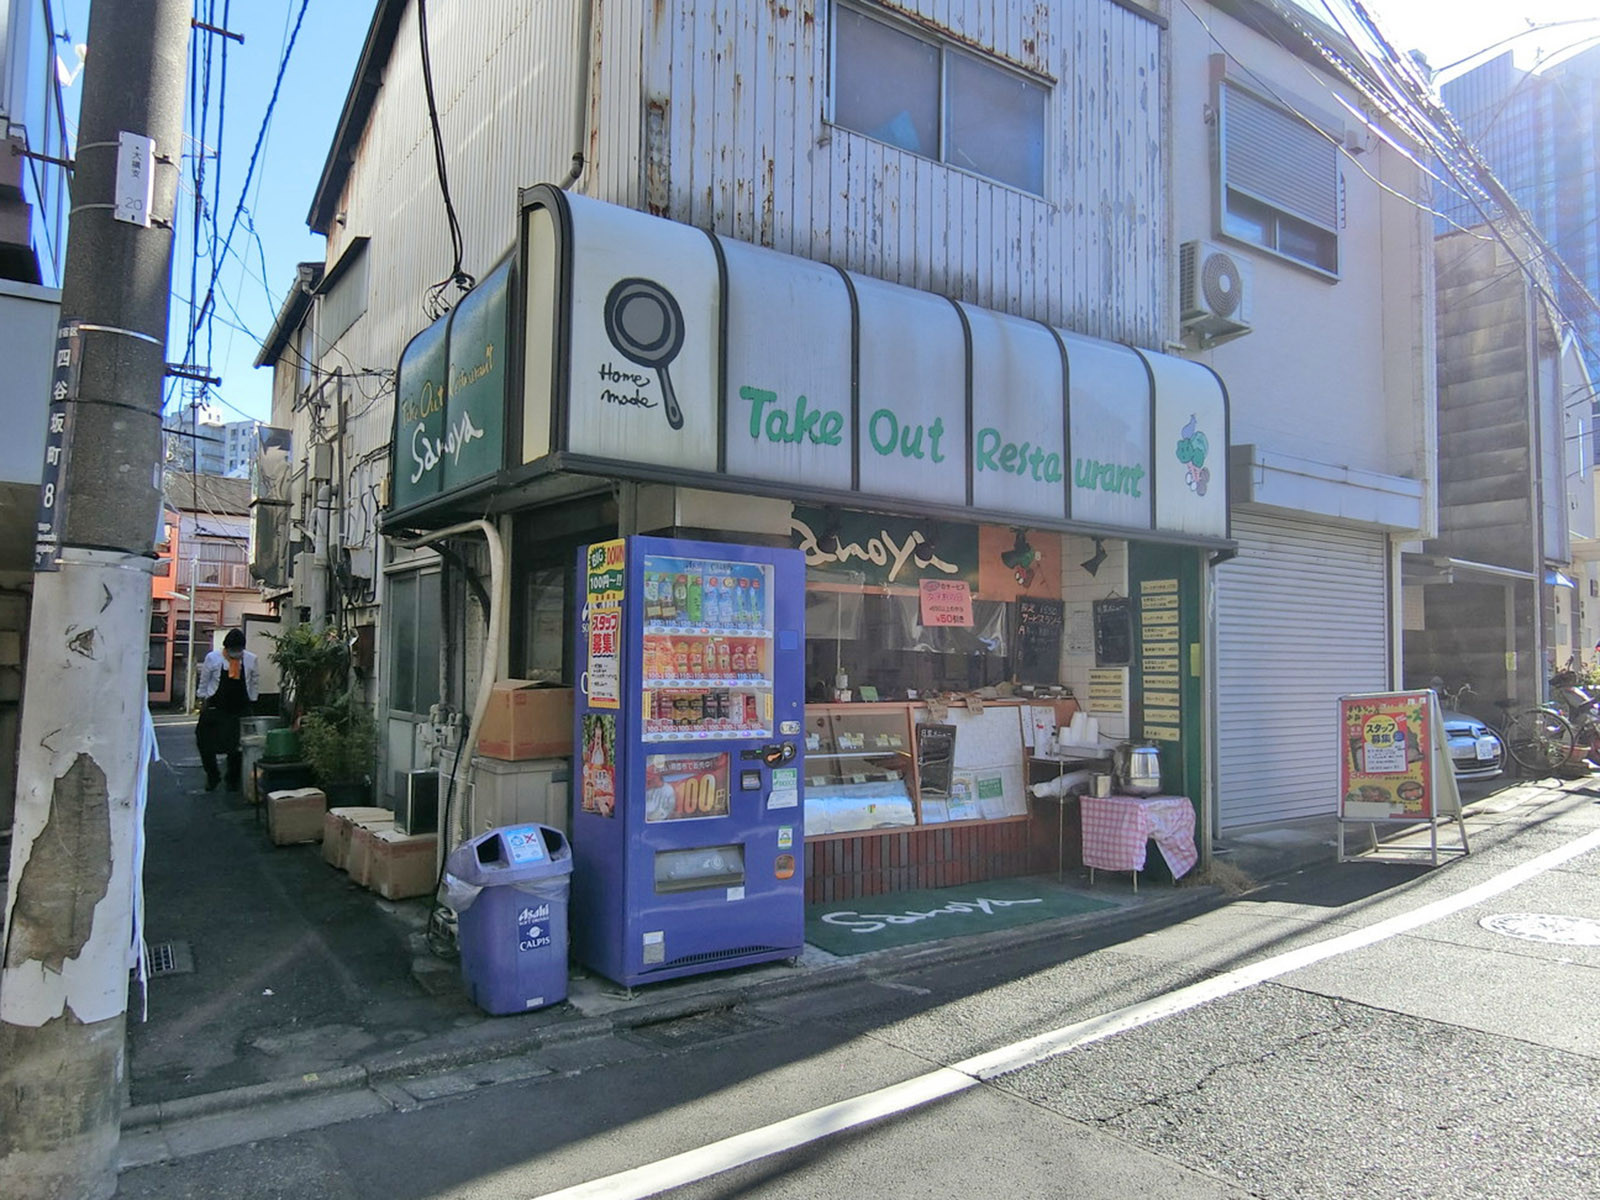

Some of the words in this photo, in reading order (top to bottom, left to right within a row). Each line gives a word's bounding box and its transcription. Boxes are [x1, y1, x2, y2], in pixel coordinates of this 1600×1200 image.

[125, 196, 143, 211] 20
[598, 362, 650, 387] Home
[48, 348, 71, 467] 四谷坂町
[601, 389, 658, 408] made
[739, 385, 844, 446] Take
[869, 408, 945, 463] Out
[976, 427, 1146, 498] Restaurant
[44, 483, 55, 508] 8
[591, 548, 604, 568] BIG
[593, 613, 617, 631] スタッフ
[1366, 723, 1395, 734] スタッフ
[519, 903, 549, 921] Asahi
[520, 936, 550, 951] CALPIS
